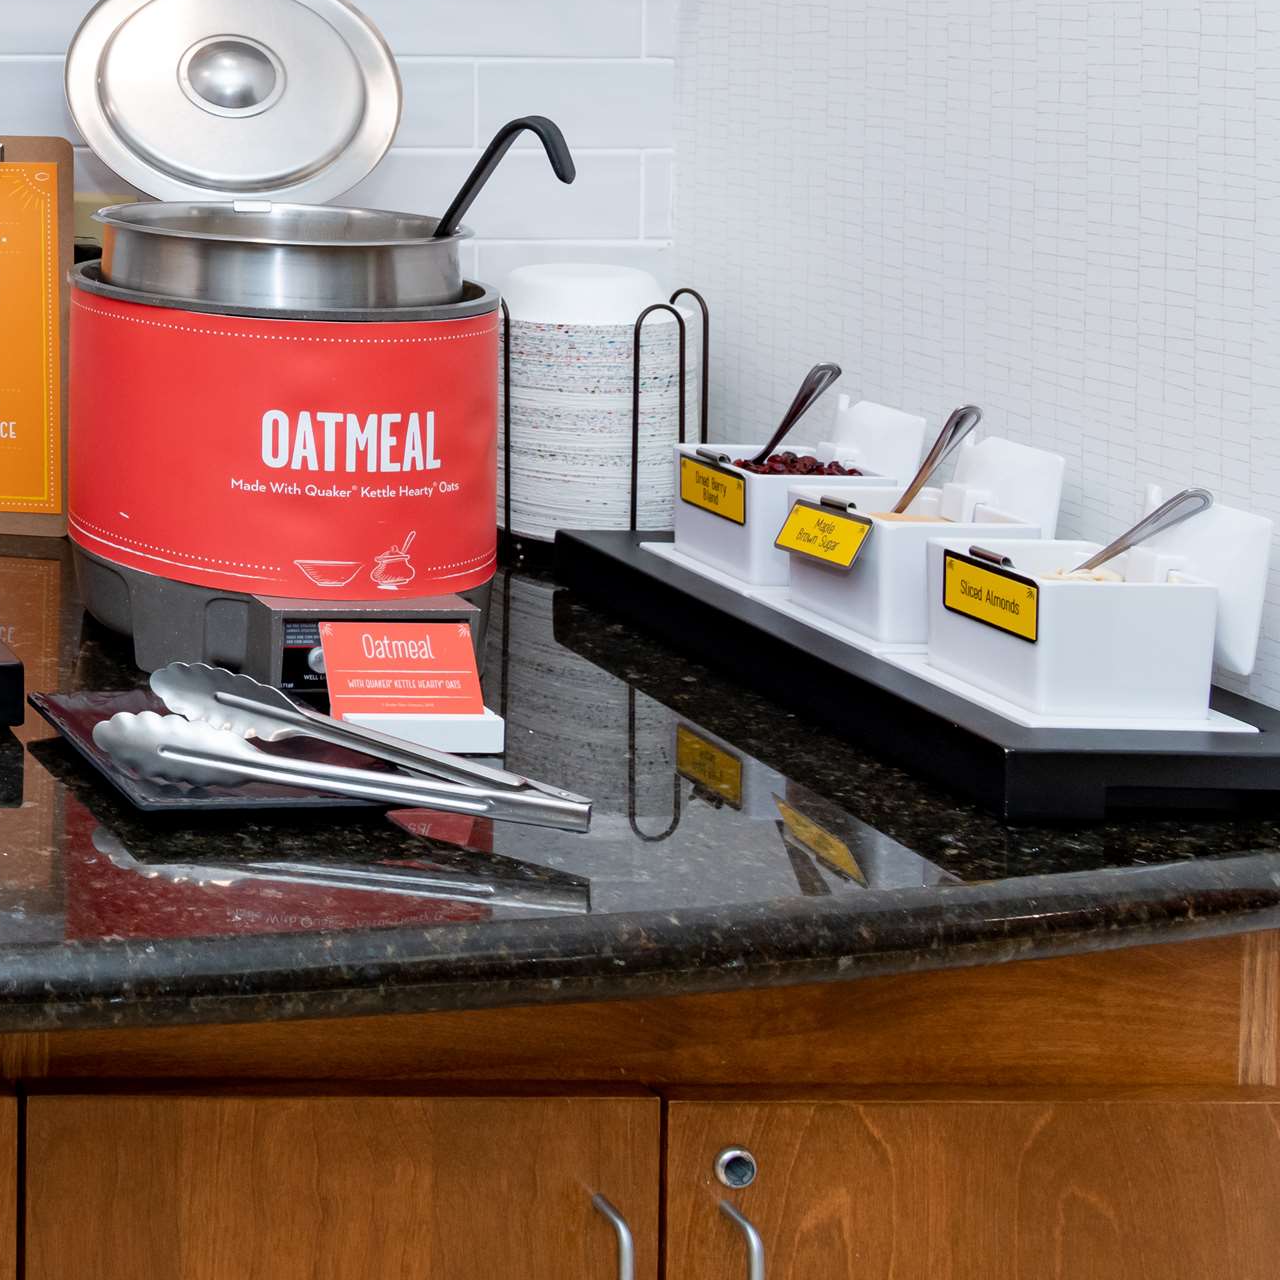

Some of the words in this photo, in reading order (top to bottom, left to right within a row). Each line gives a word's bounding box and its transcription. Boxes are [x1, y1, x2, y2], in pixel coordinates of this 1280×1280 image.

[261, 409, 441, 473] OATMEAL
[231, 478, 267, 493] Made
[269, 481, 302, 495] With
[360, 485, 397, 498] Kettle
[438, 480, 460, 493] Oats
[695, 470, 710, 488] Dried
[711, 476, 728, 497] Berry
[703, 488, 720, 505] Blend
[815, 518, 836, 535] Maple
[796, 527, 817, 545] Brown
[818, 535, 840, 553] Sugar
[960, 579, 983, 601] Sliced
[985, 589, 1020, 615] Almonds
[361, 633, 435, 660] Oatmeal
[347, 679, 364, 689] WITH
[394, 679, 416, 689] KETTLE
[445, 679, 461, 689] OATS
